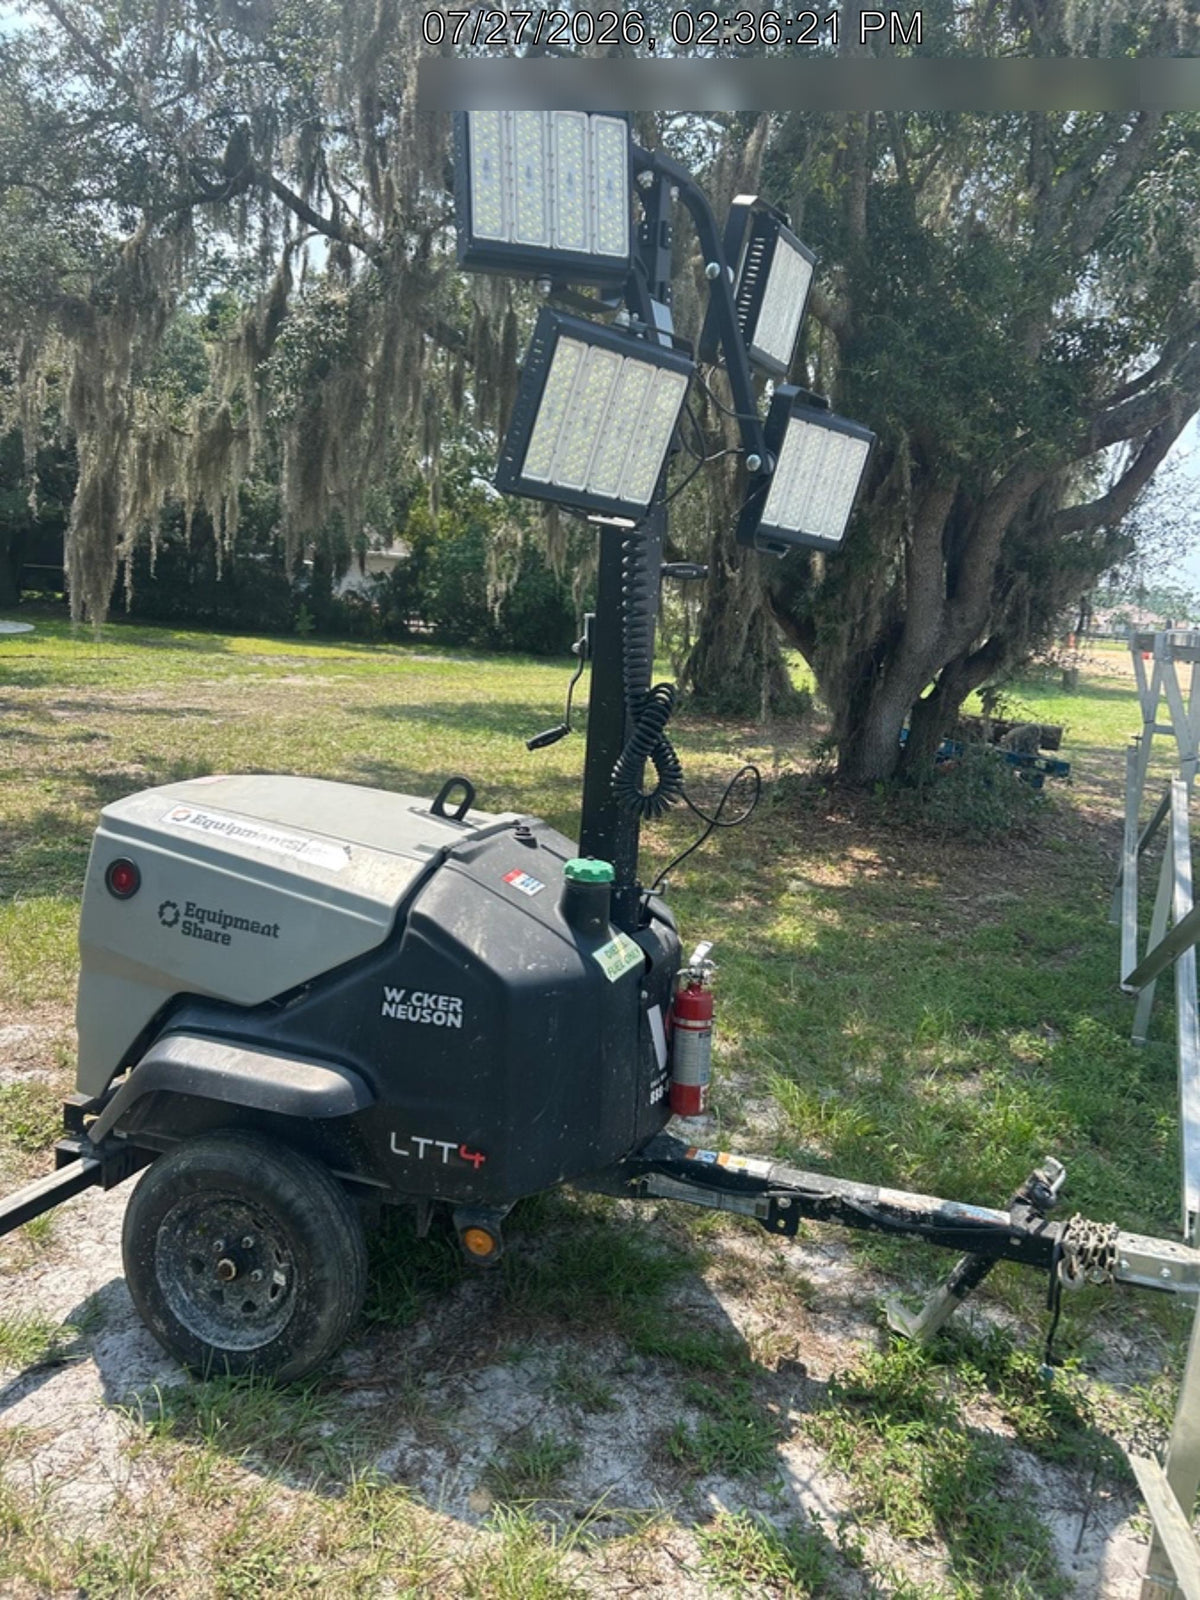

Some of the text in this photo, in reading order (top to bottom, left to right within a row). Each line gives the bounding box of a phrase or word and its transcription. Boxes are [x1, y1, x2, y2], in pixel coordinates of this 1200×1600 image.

[181, 920, 232, 946] Share
[184, 901, 280, 939] Equipment
[383, 986, 463, 1013] WCKER
[381, 1001, 463, 1029] NEUSON
[390, 1131, 486, 1169] LTT4
